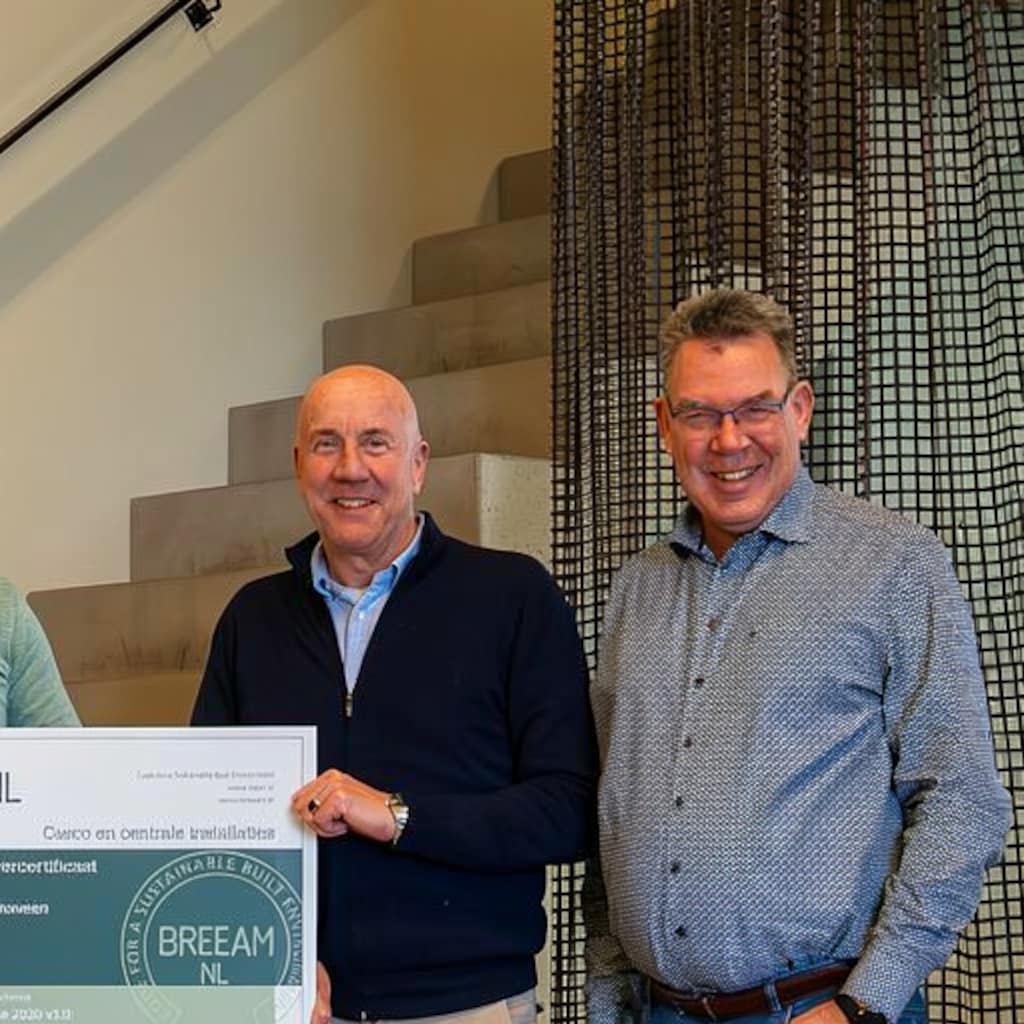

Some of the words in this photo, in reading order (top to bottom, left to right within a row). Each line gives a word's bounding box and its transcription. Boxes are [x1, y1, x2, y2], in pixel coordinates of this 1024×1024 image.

[127, 941, 140, 975] FOR
[241, 861, 285, 897] BUILT
[159, 925, 274, 957] BREEAM
[200, 962, 229, 985] NL
